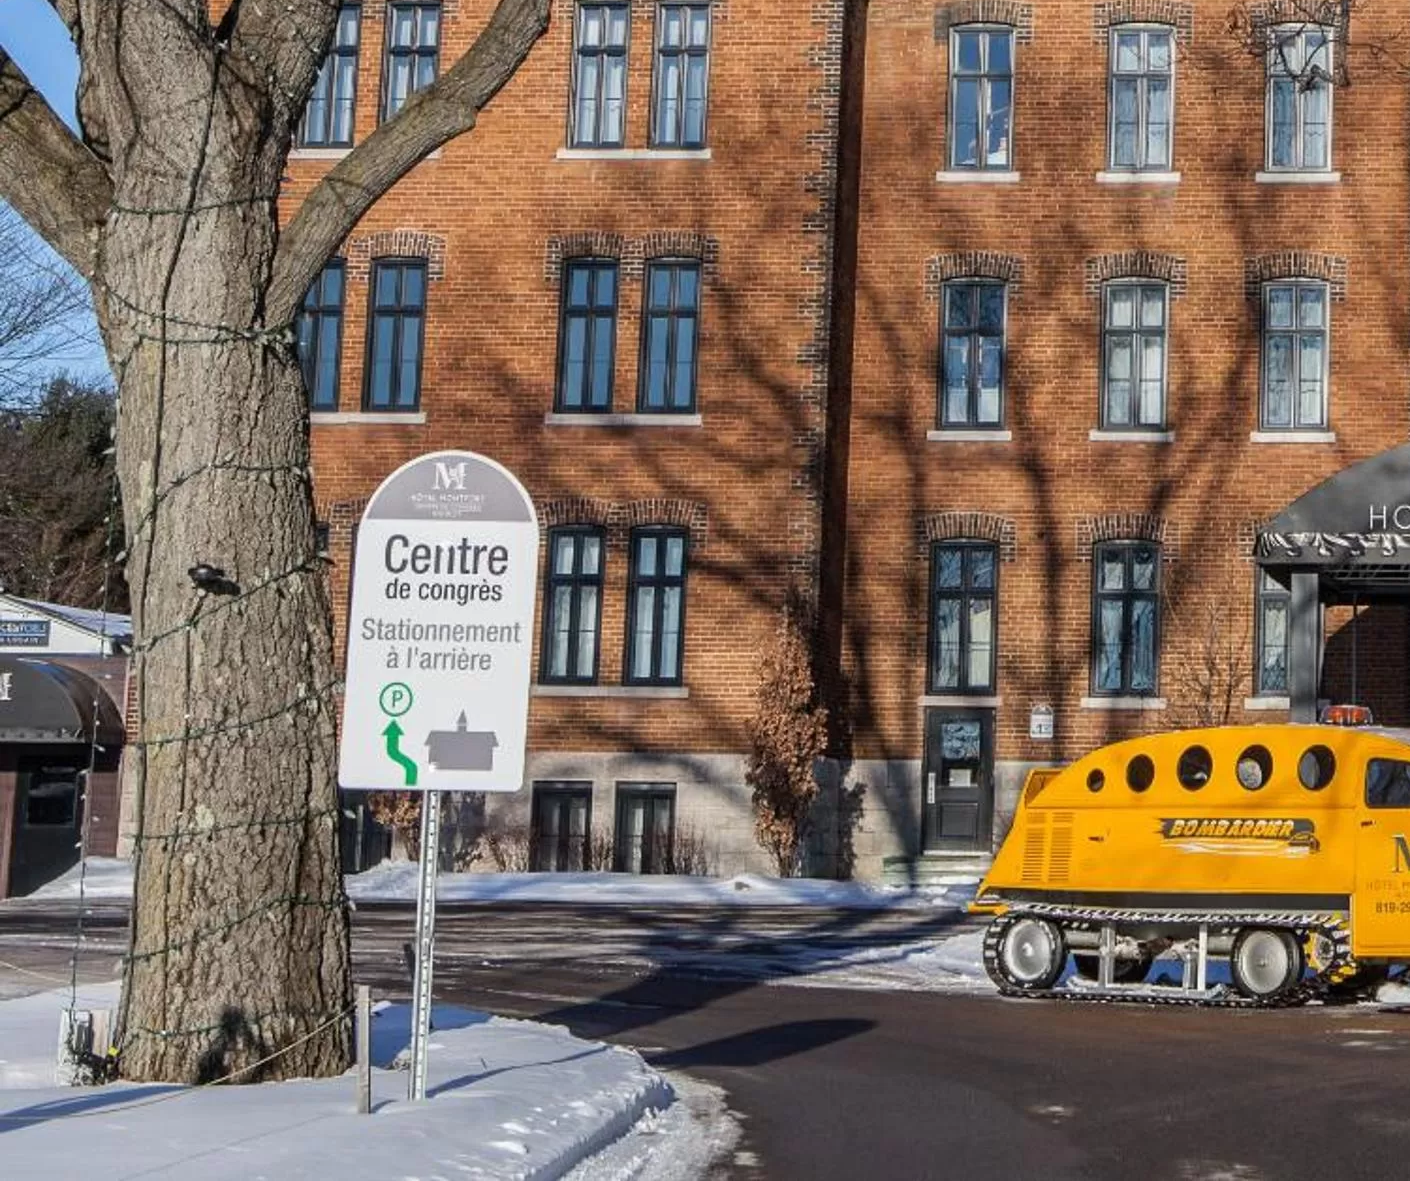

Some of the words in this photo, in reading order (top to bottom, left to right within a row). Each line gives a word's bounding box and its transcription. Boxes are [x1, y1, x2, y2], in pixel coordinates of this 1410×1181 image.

[384, 534, 509, 575] Centre
[385, 578, 411, 600] de
[418, 579, 503, 606] congrès
[362, 618, 523, 643] Stationnement
[386, 646, 399, 669] à
[407, 647, 492, 671] l'arrière
[1169, 820, 1294, 836] BOMBARDIER
